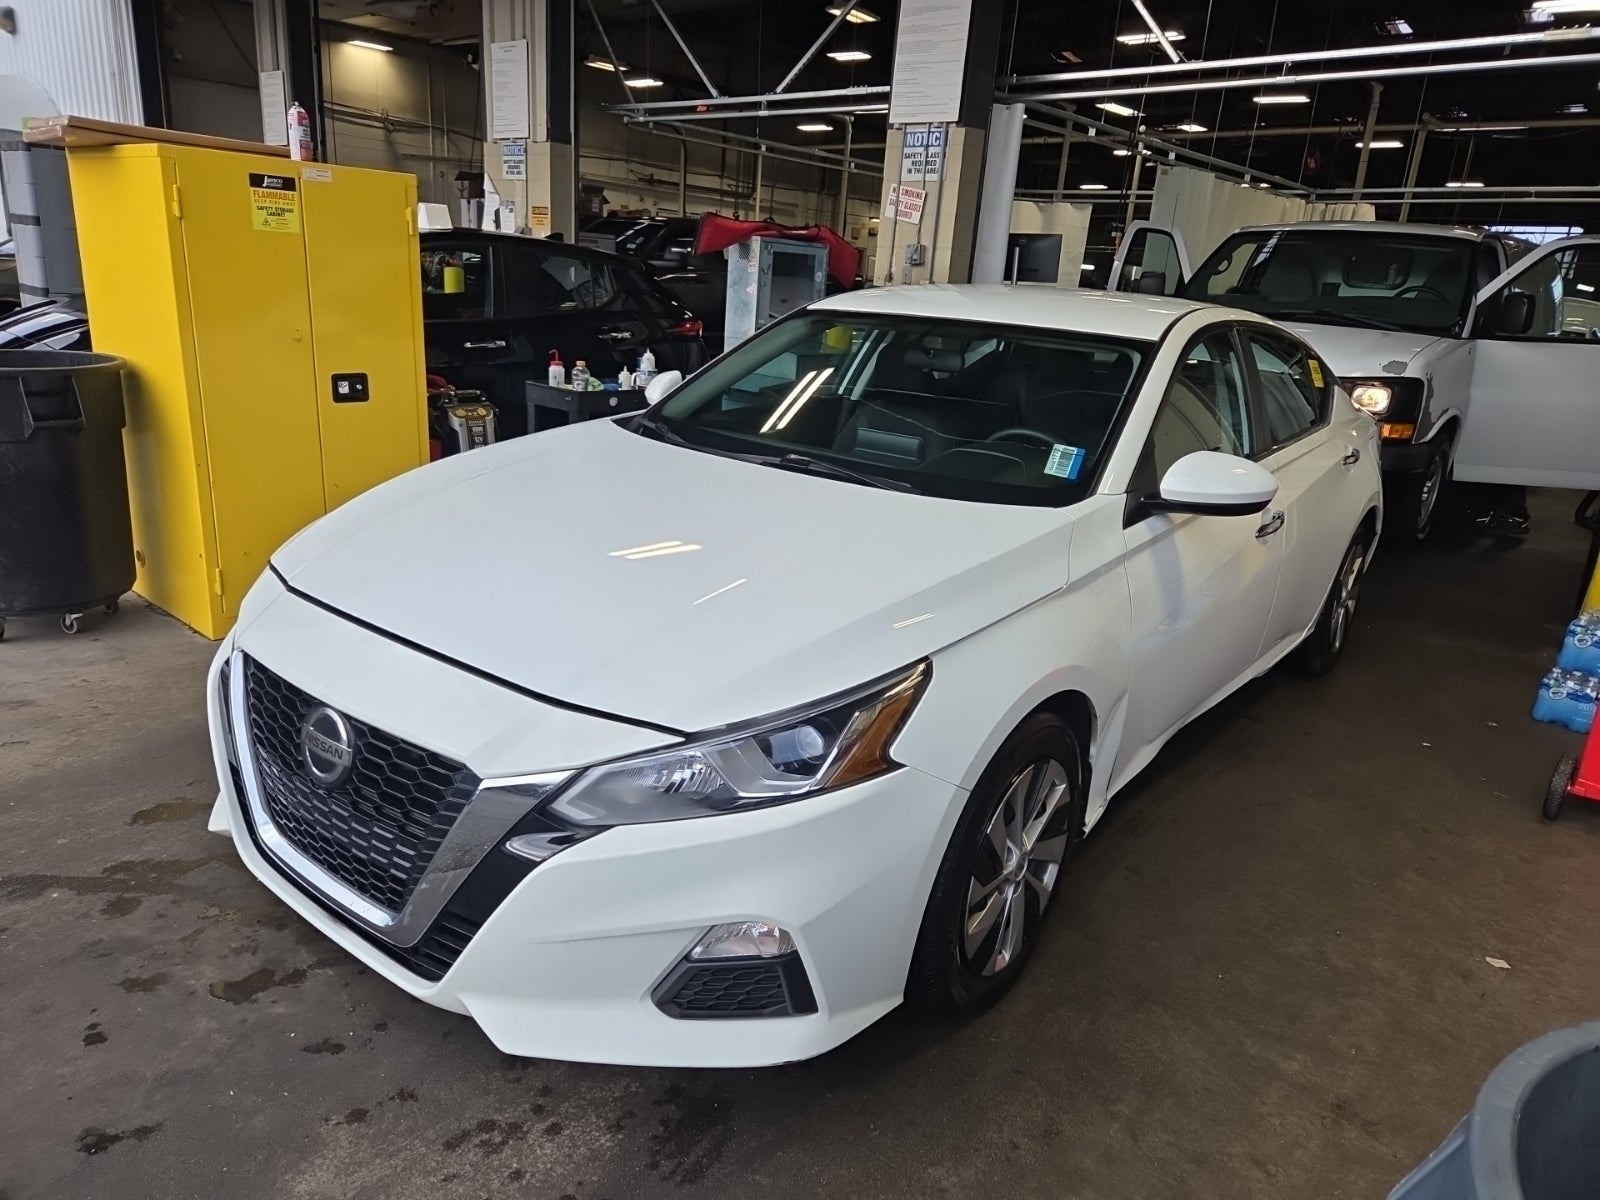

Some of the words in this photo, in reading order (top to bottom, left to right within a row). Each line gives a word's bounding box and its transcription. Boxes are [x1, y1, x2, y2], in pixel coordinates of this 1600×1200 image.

[503, 145, 524, 155] NOTICE
[253, 190, 296, 201] FLAMMABLE
[901, 188, 924, 200] SMOKING
[306, 733, 343, 760] NISSAN
